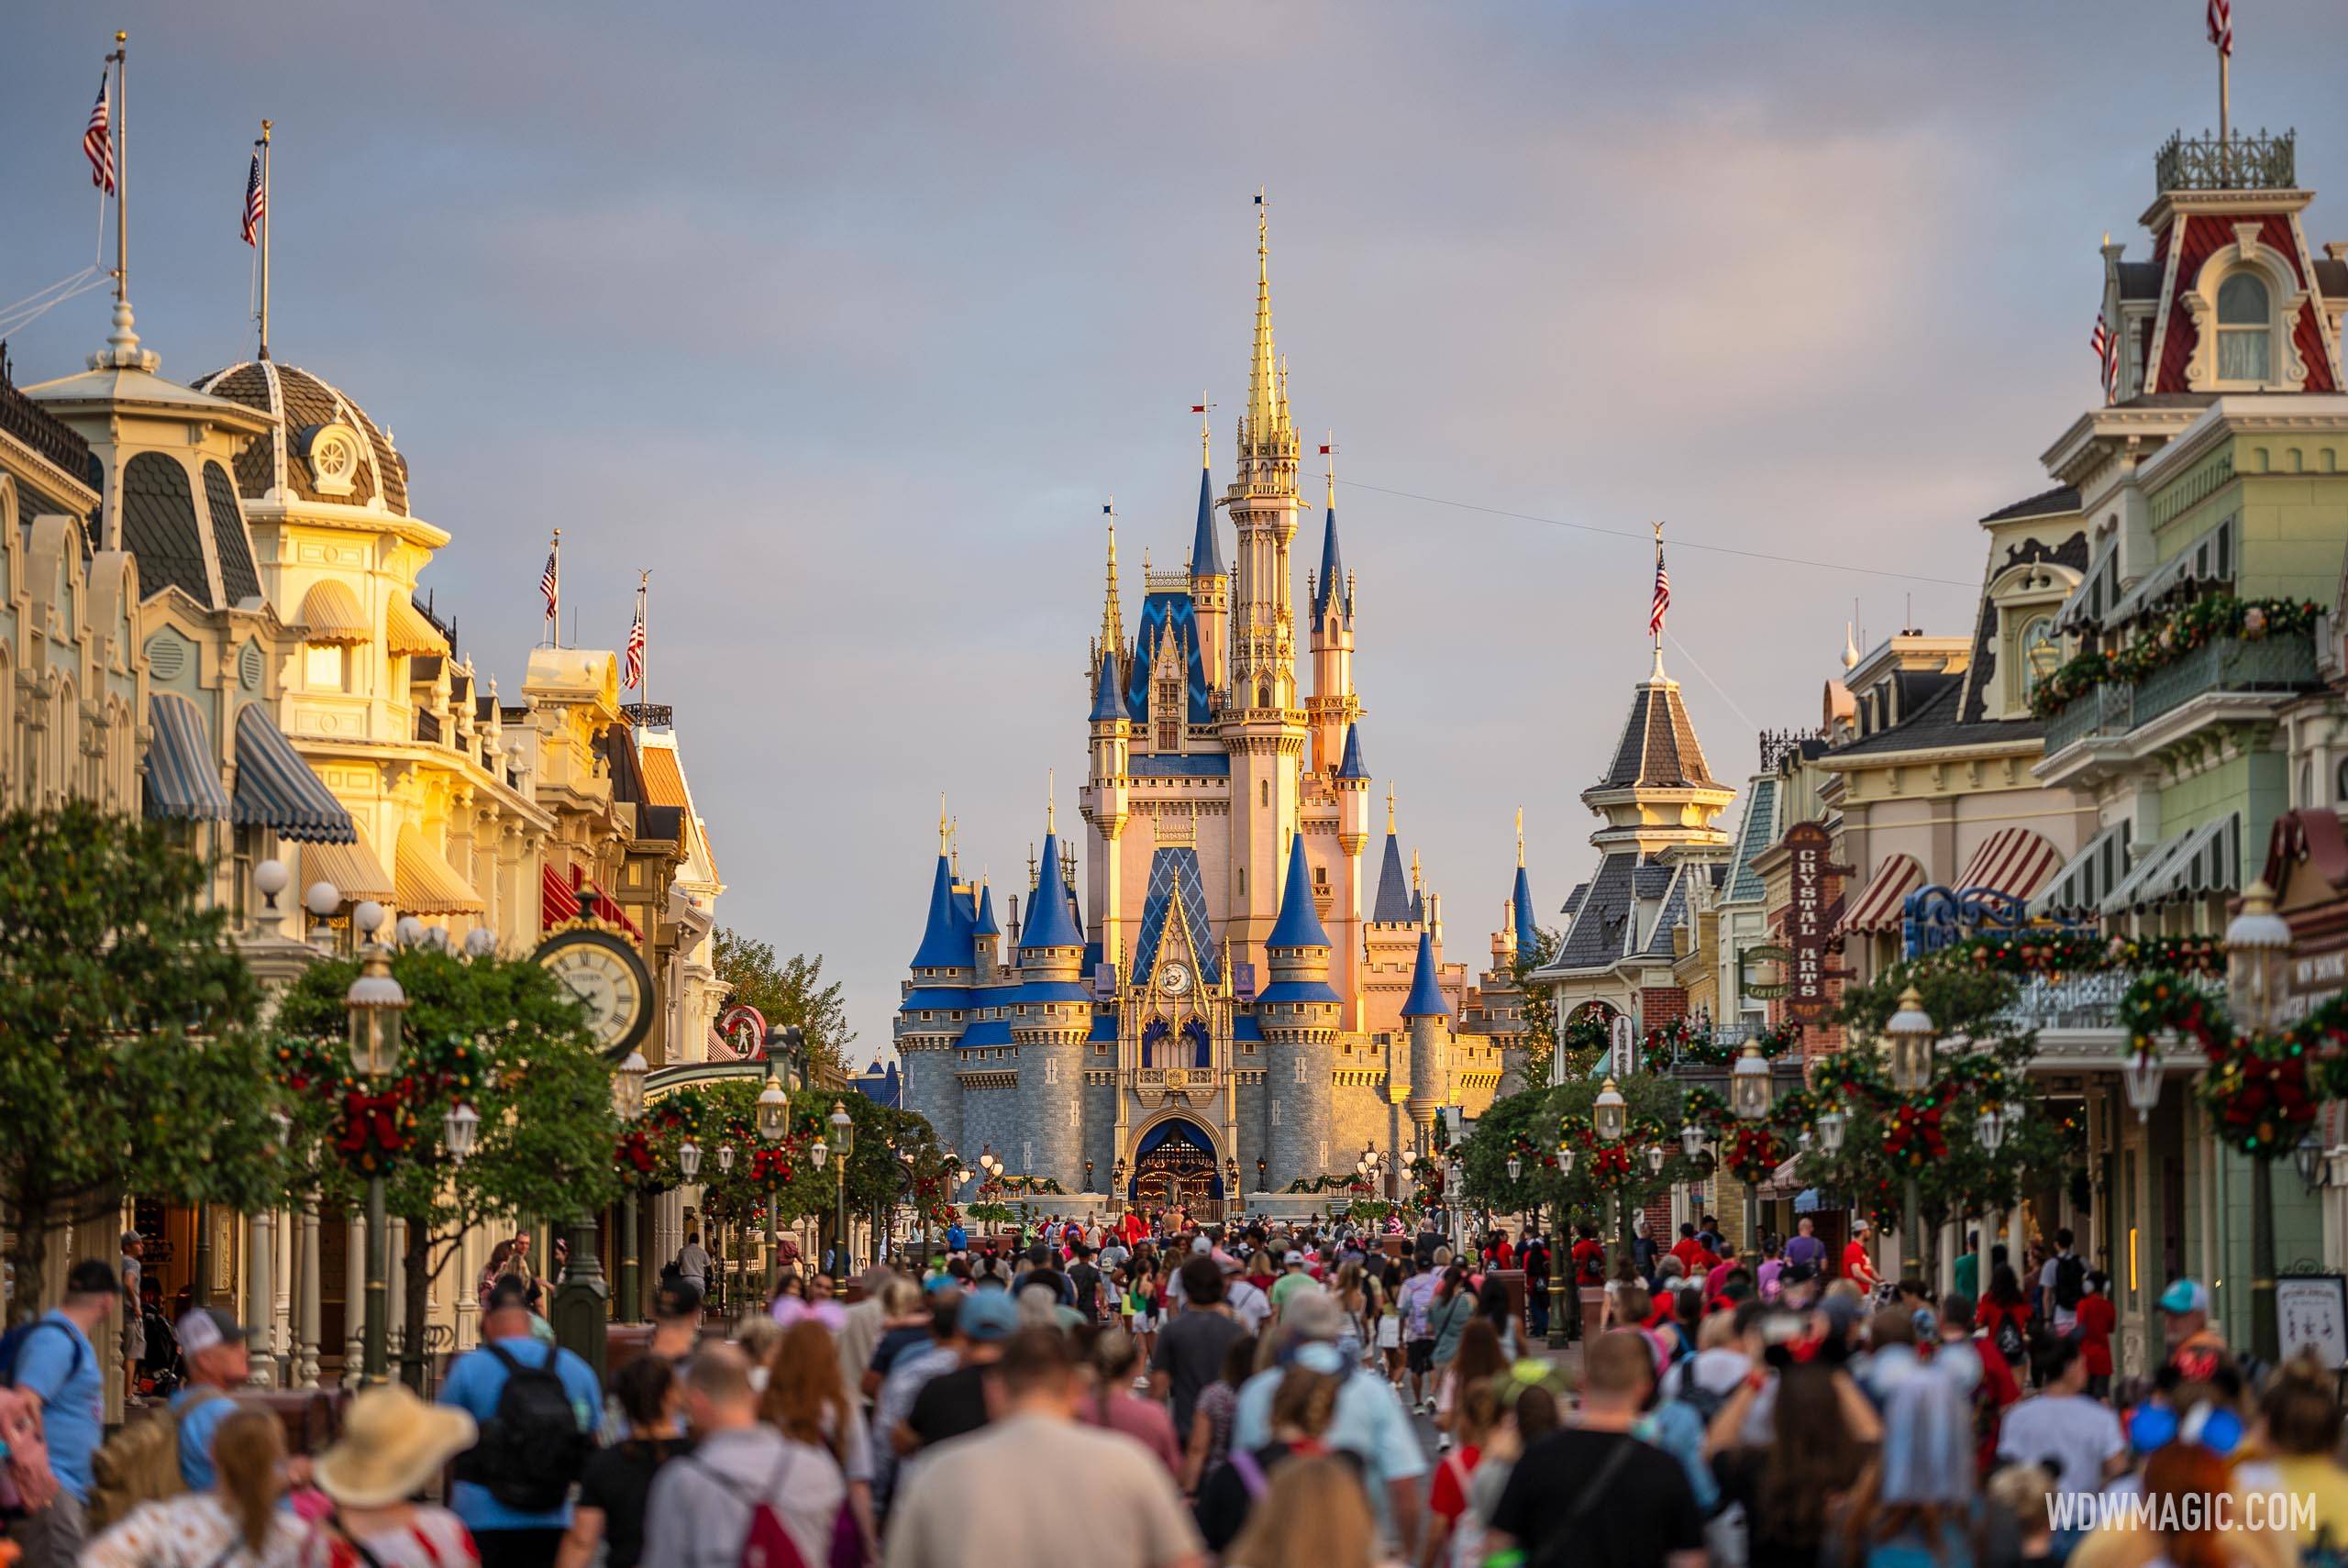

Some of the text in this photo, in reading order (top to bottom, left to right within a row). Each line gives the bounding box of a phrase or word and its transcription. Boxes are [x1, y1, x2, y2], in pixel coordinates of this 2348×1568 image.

[1799, 849, 1818, 998] CRYSTAL ARTS
[1749, 987, 1785, 999] COFFEE
